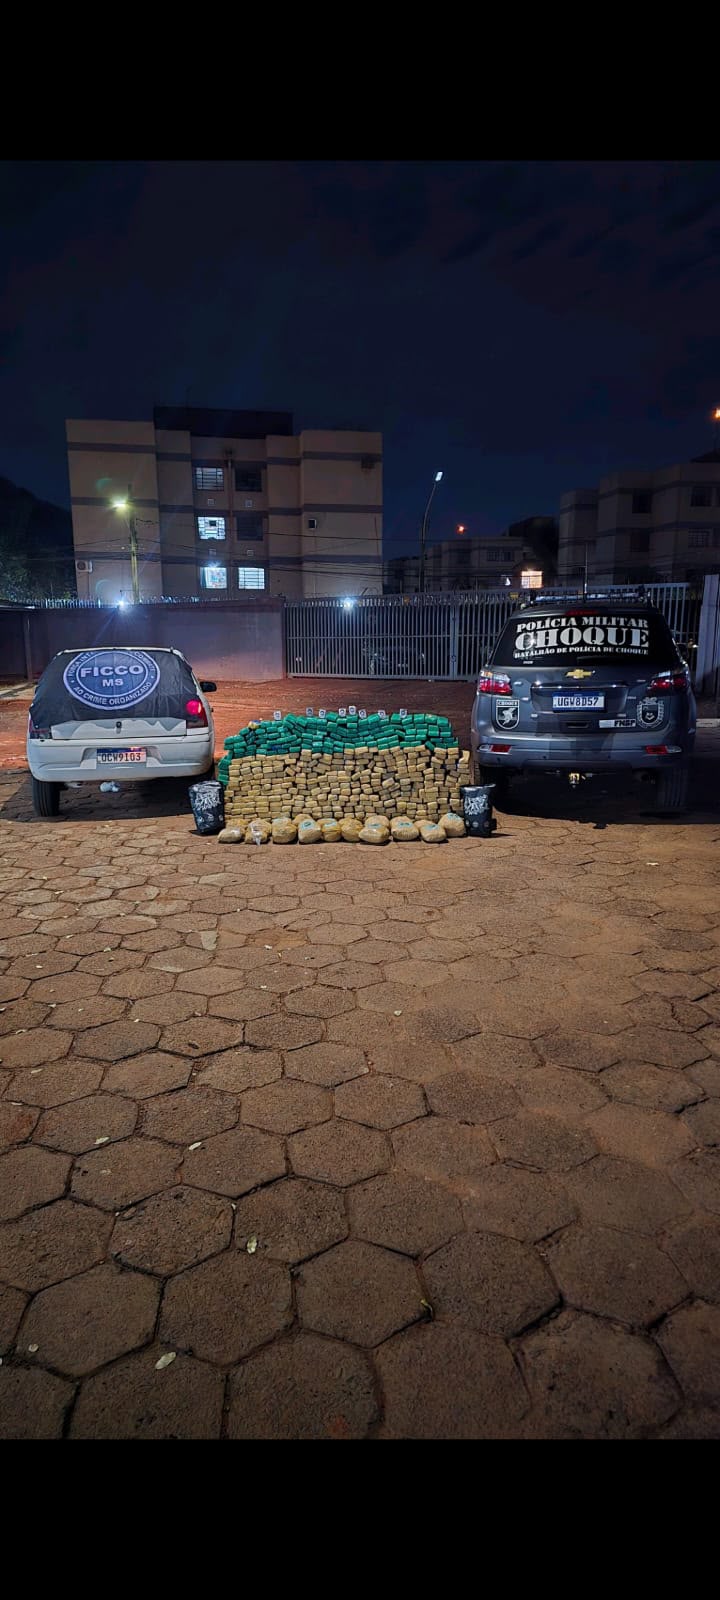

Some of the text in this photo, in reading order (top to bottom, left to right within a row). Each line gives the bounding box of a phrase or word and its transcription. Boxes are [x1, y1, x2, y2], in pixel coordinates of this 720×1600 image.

[516, 616, 649, 633] POLÍCIA MILITAR
[515, 627, 650, 651] CHOQUE
[514, 648, 556, 659] BATALHÃO
[569, 645, 602, 653] POLÍCIA
[615, 647, 649, 655] CHOQUE
[80, 665, 144, 678] FICCO
[102, 678, 124, 687] MS
[73, 681, 152, 706] AO CRIME ORGANIZADO
[557, 696, 599, 707] UGW8D57
